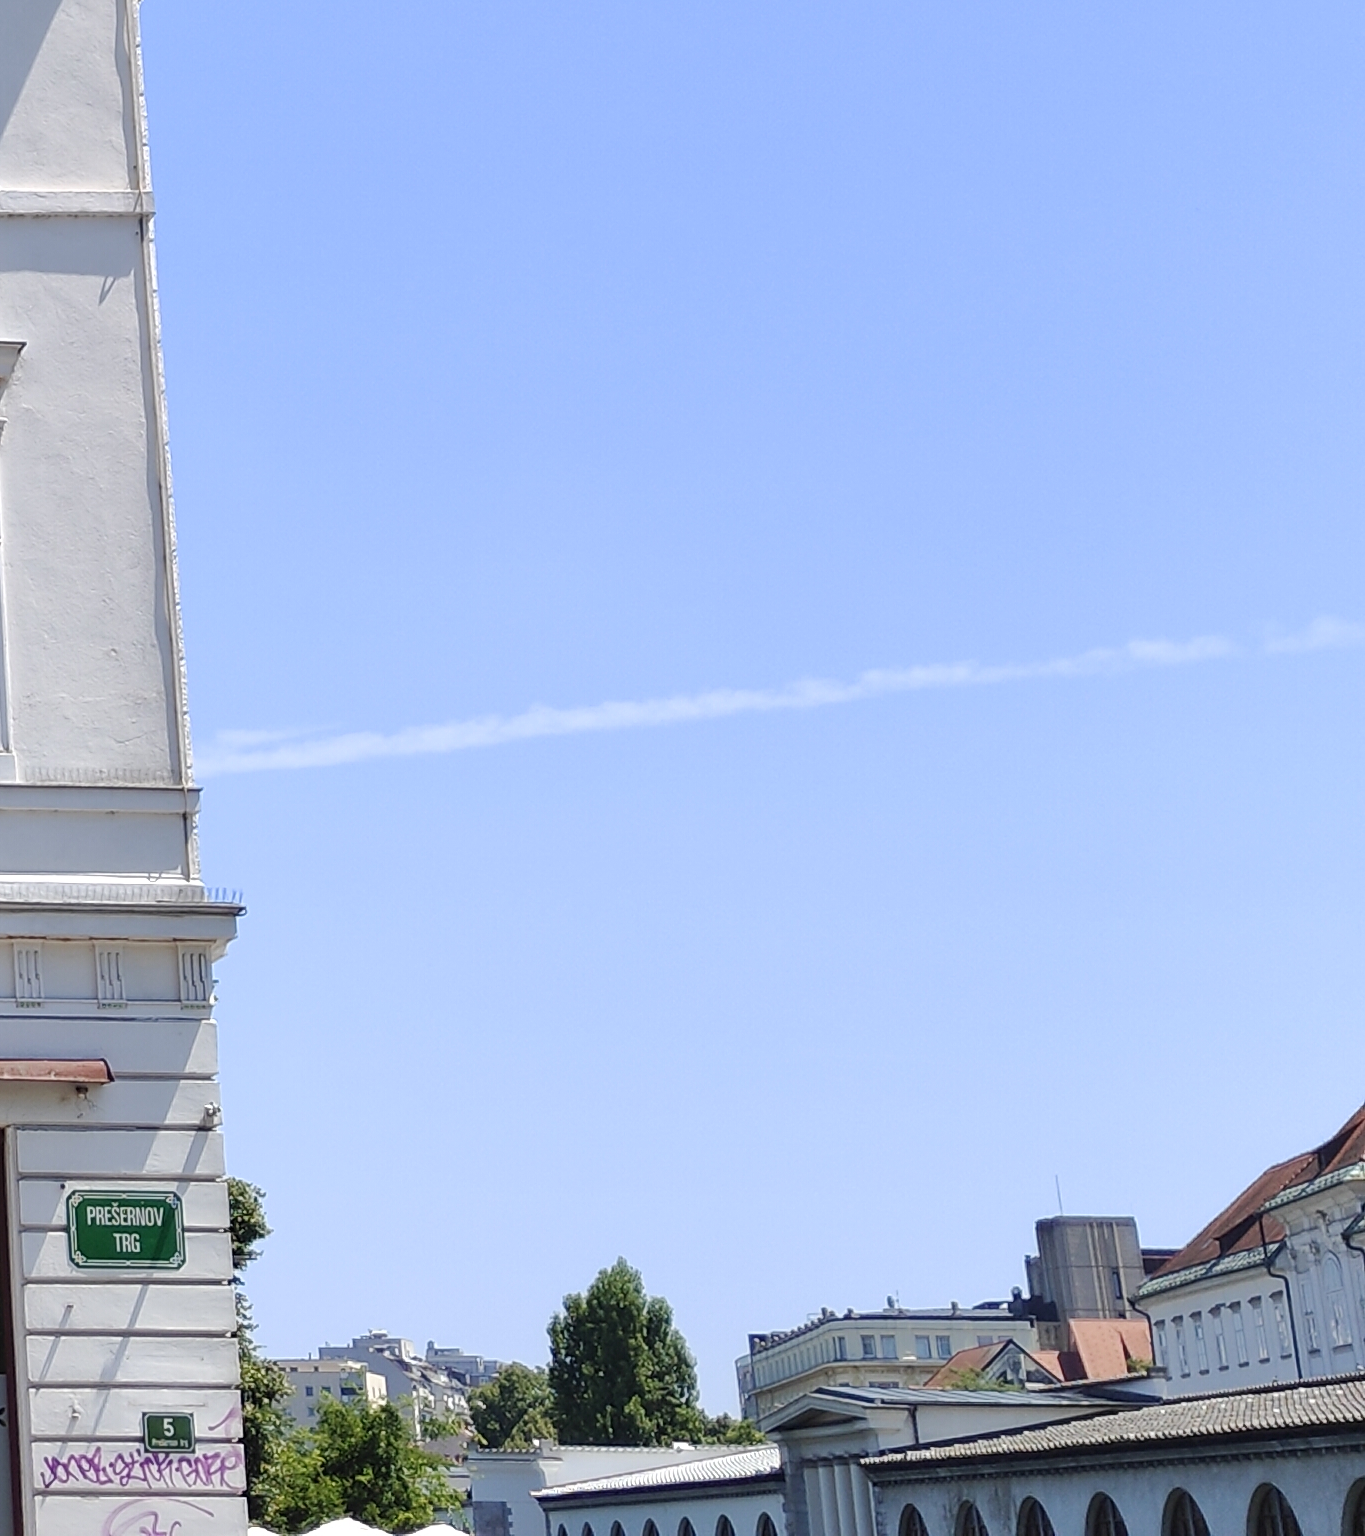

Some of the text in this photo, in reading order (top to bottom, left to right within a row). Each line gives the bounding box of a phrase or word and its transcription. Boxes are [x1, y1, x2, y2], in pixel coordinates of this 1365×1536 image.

[86, 1202, 164, 1226] PREŠERNOV
[113, 1233, 141, 1253] TRG
[163, 1418, 175, 1437] 5
